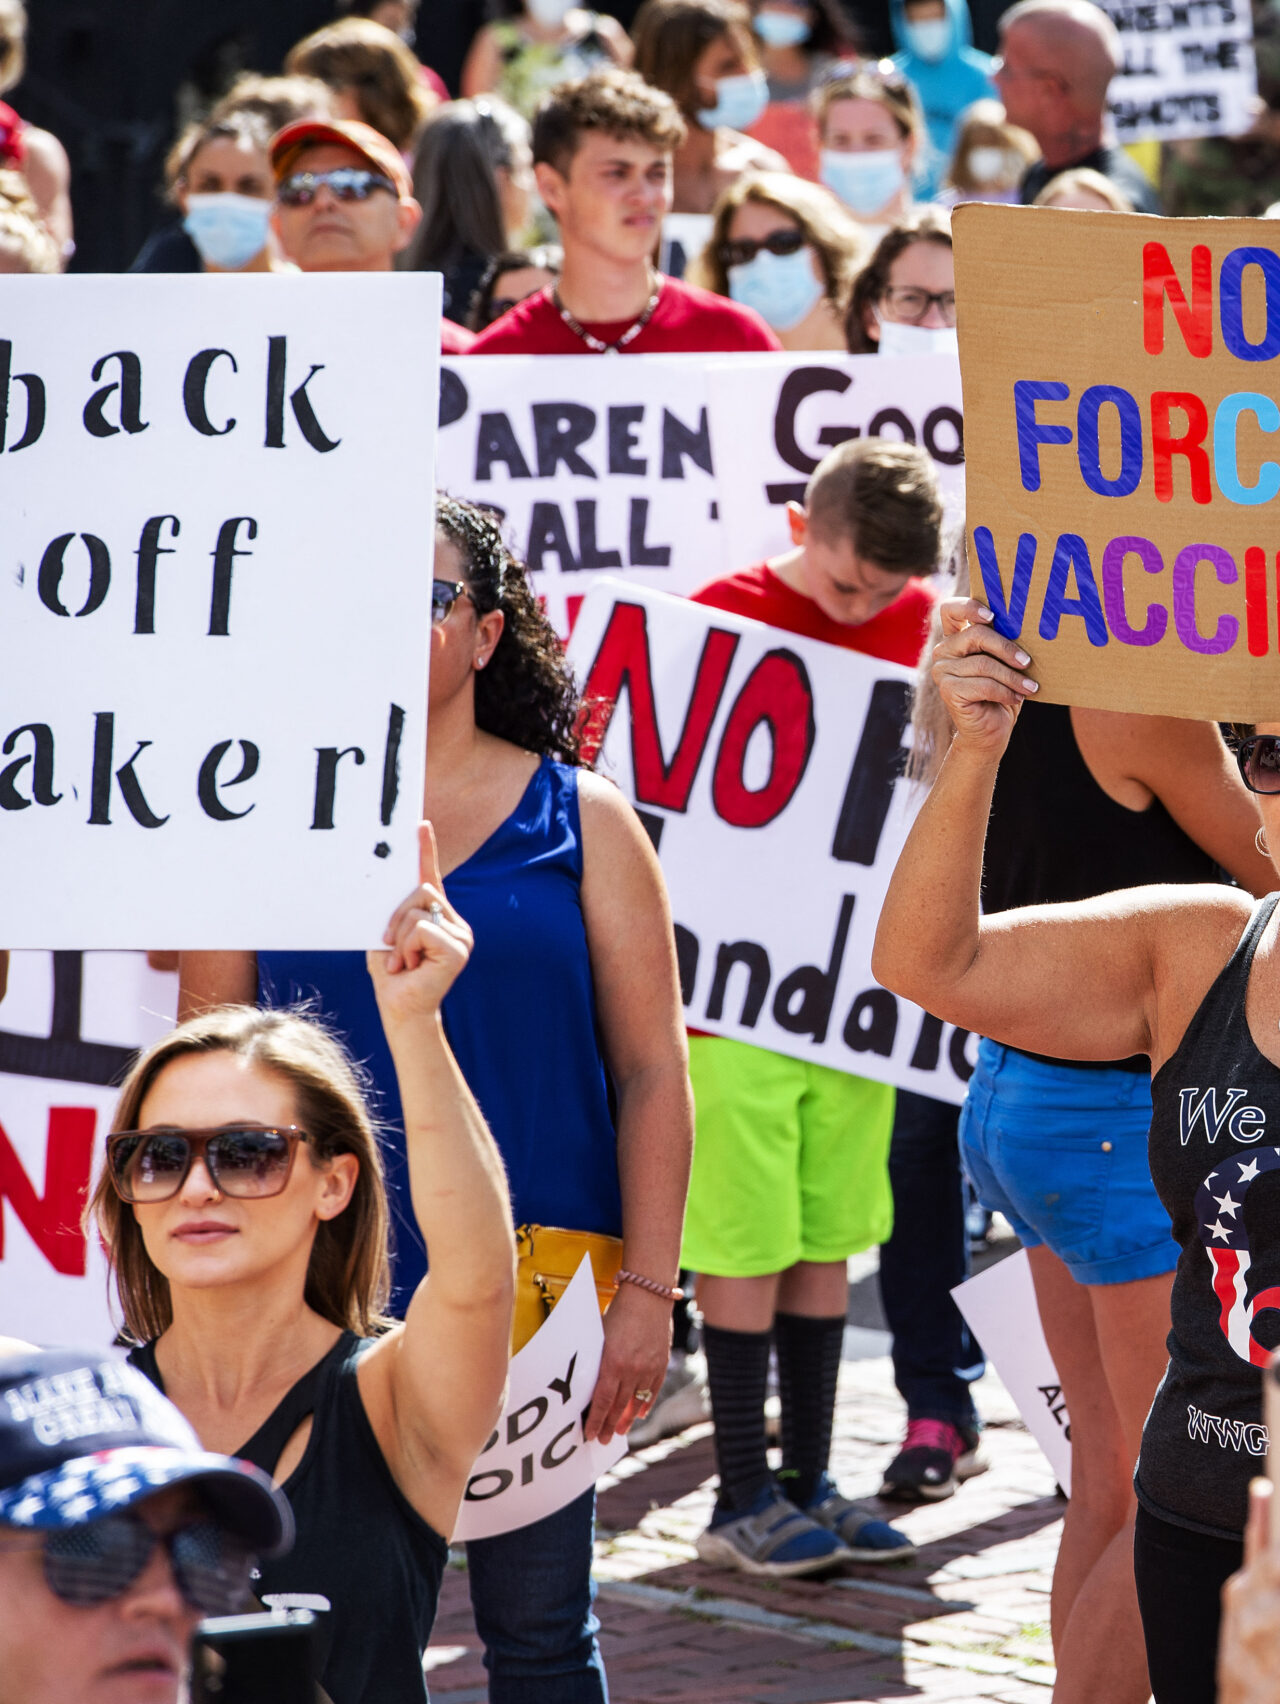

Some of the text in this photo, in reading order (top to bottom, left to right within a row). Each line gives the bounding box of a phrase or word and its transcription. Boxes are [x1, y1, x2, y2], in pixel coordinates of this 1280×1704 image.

[0, 335, 342, 453] back
[37, 514, 258, 636] off
[478, 497, 672, 573] ALL
[572, 600, 817, 829] NO
[0, 703, 406, 860] aker!
[1178, 1086, 1267, 1147] We
[1186, 1404, 1271, 1457] WWG
